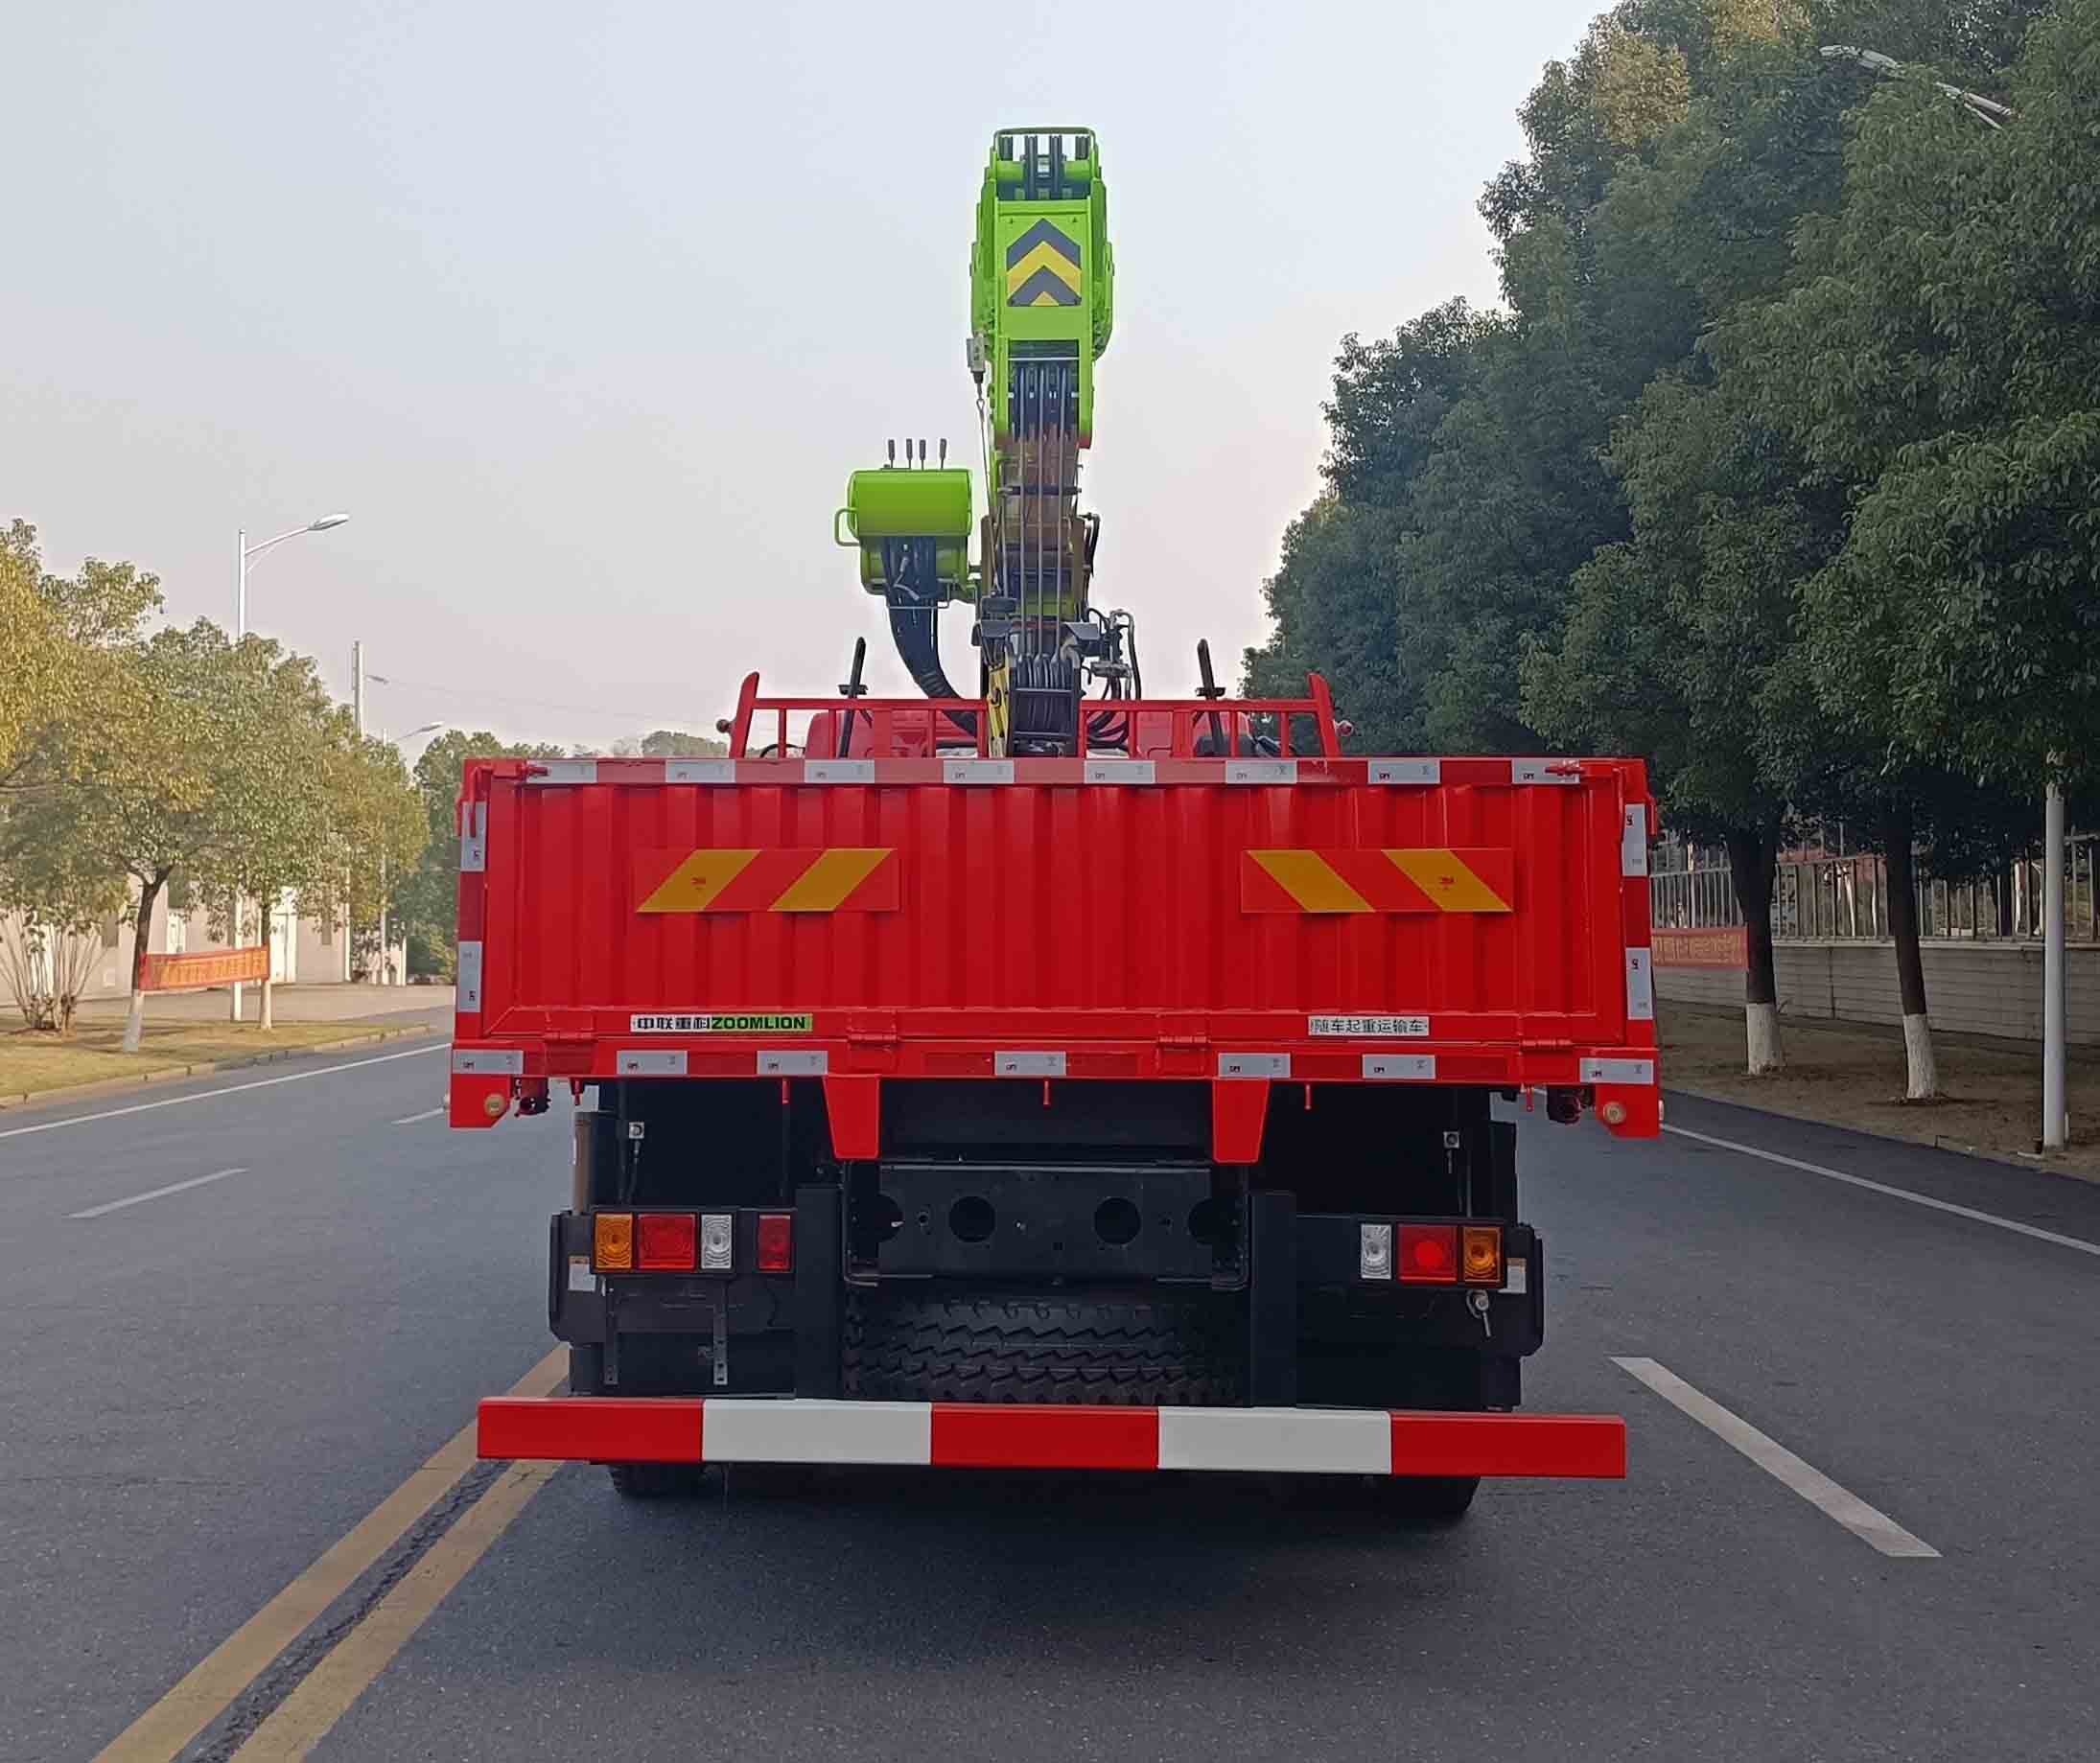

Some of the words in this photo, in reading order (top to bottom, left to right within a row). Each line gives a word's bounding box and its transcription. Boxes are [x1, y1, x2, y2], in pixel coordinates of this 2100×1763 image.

[712, 1016, 806, 1030] ZOOMLION
[1310, 1018, 1425, 1033] 随车起重运输车
